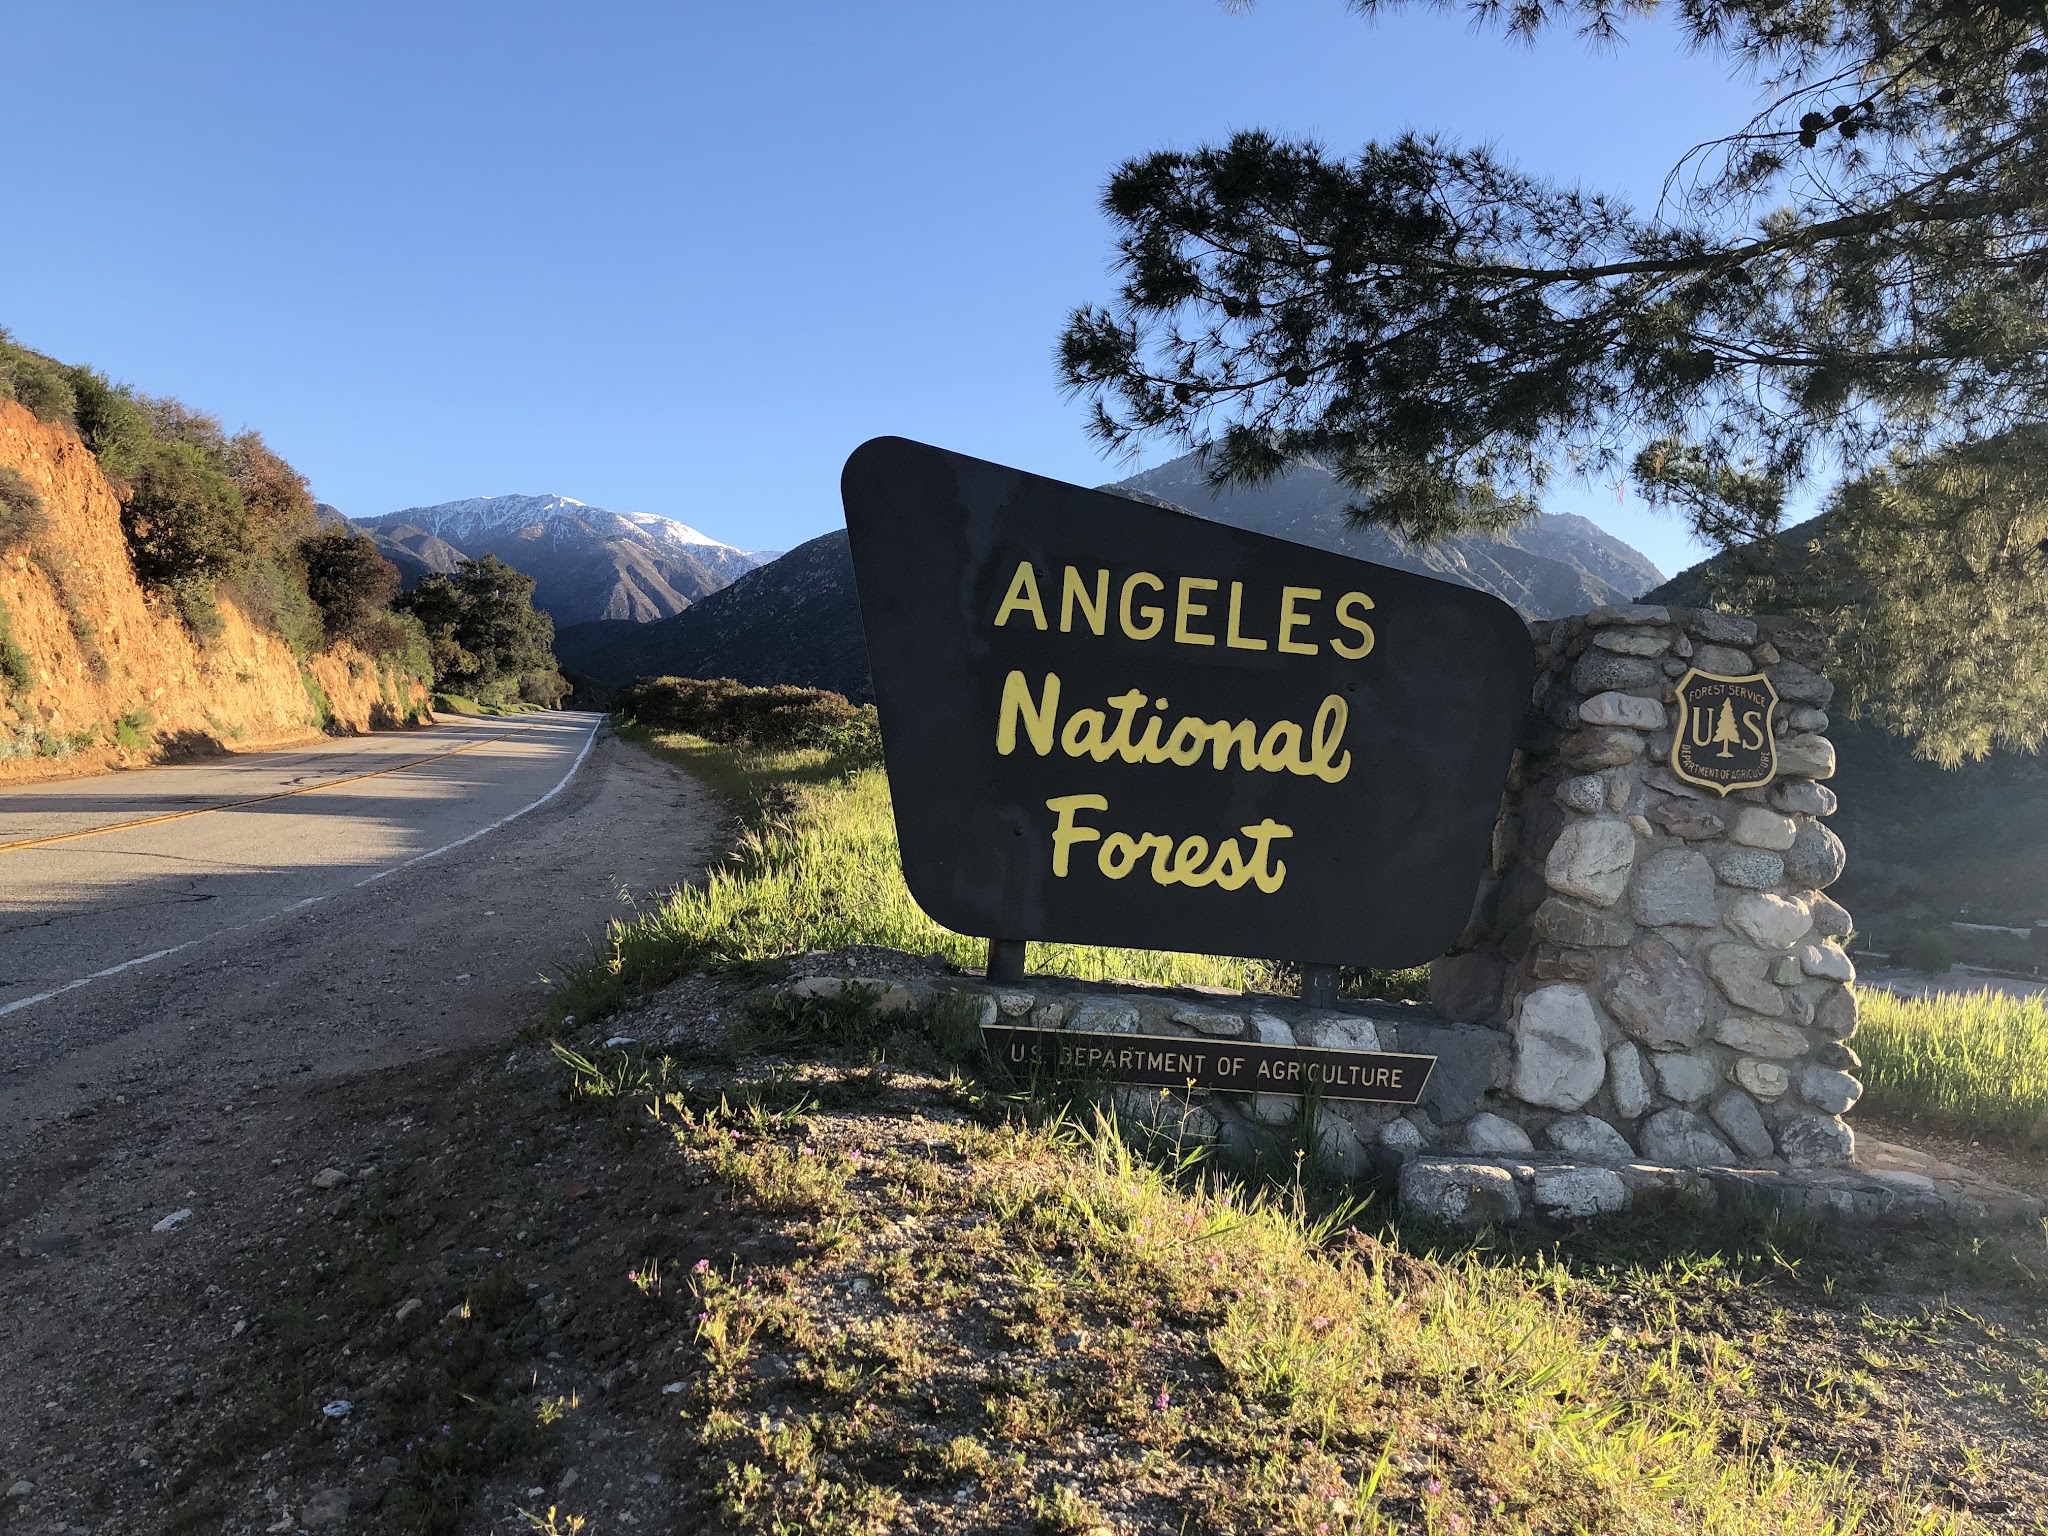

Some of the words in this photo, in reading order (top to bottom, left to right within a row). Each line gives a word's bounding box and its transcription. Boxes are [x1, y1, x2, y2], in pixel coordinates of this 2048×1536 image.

[994, 561, 1376, 660] ANGELES
[996, 670, 1352, 784] National
[1689, 684, 1725, 702] FOREST
[1728, 685, 1766, 708] SERVICE
[1681, 744, 1719, 778] DEPARTMENT
[1720, 769, 1730, 780] OF
[1731, 751, 1770, 780] AGRICULTURE
[1045, 793, 1294, 894] Forest
[1058, 1046, 1207, 1074] DEPARTMENT
[1217, 1056, 1246, 1077] OF
